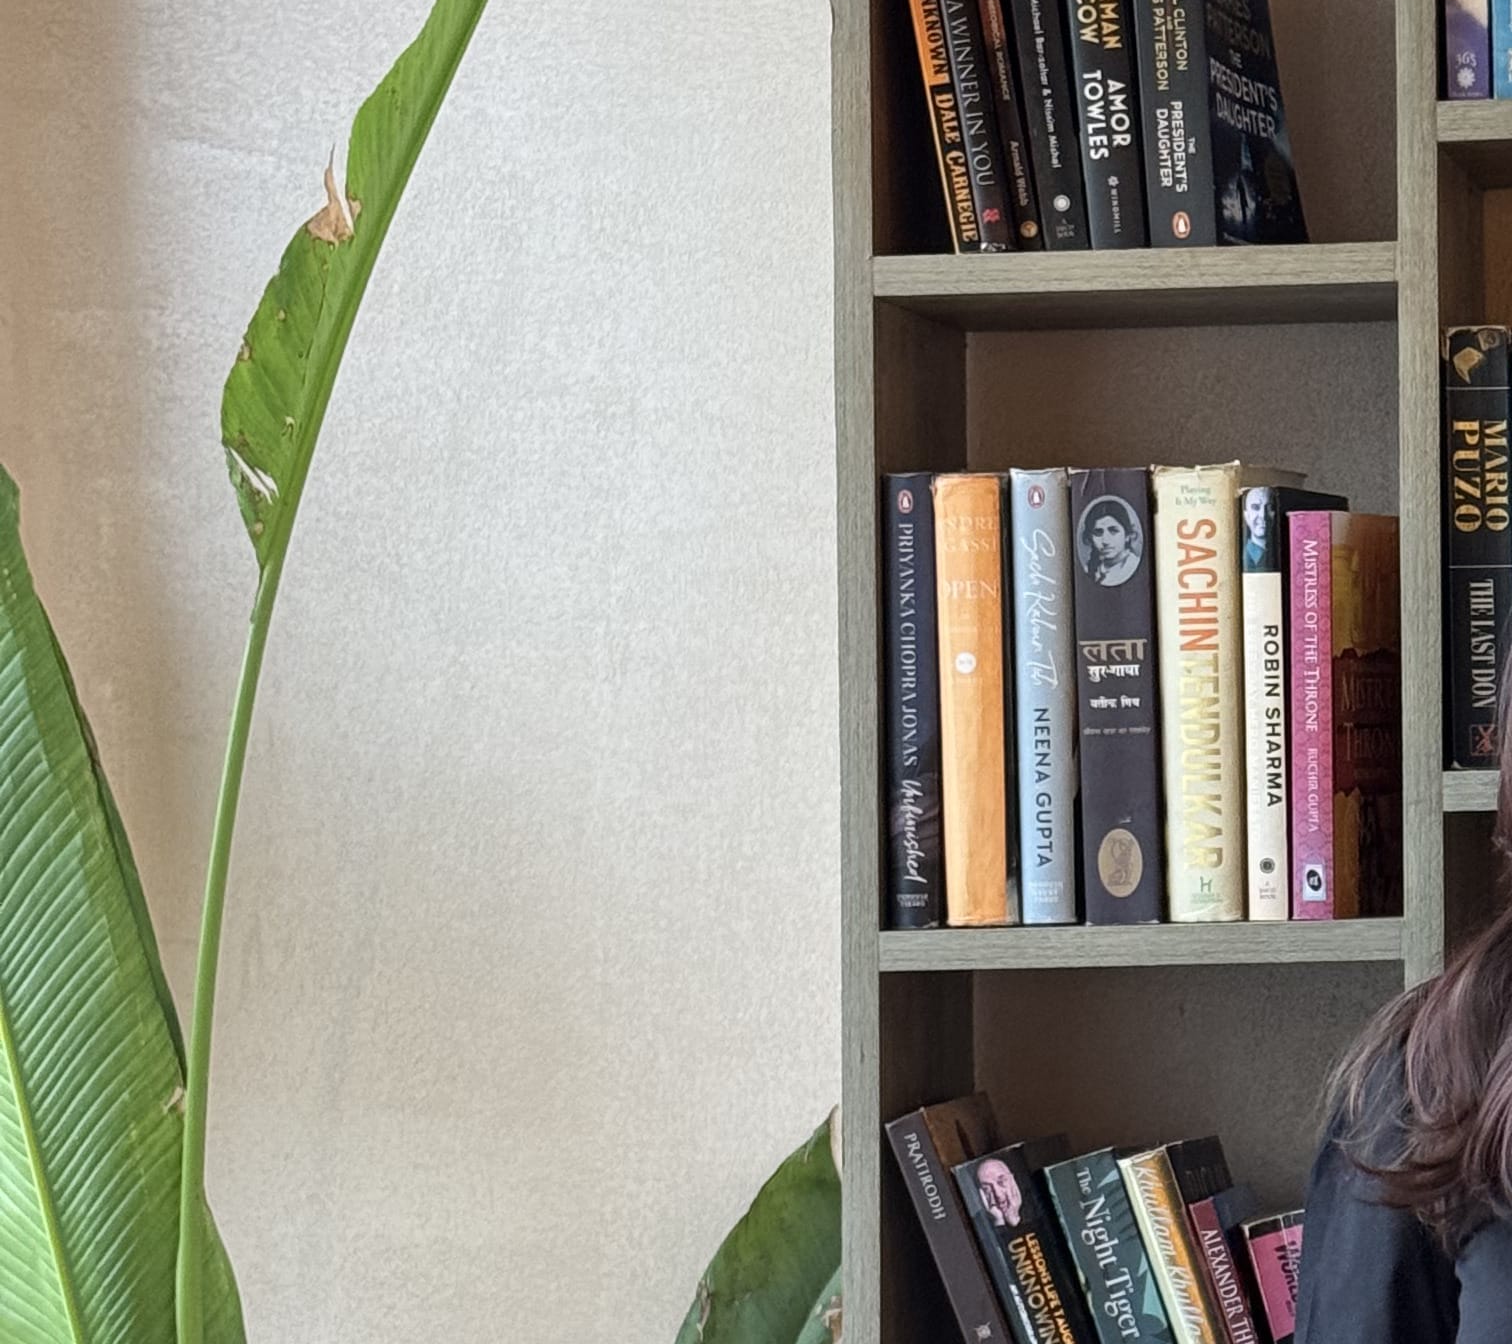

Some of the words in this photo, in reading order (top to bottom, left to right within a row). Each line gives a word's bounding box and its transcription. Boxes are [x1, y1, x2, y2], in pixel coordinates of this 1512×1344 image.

[945, 0, 963, 13] A
[1173, 8, 1188, 71] CLINTON
[949, 15, 982, 107] WINNER
[1152, 7, 1169, 91] PATTERSON
[965, 112, 988, 135] IN
[1083, 70, 1108, 160] TOWLES
[1107, 79, 1131, 147] AMOR
[1156, 108, 1172, 186] DAUGHTER
[1170, 101, 1188, 193] PRESIDENT'S
[934, 92, 962, 144] DALE
[949, 150, 978, 242] CARNEGIE
[970, 140, 995, 186] YOU
[1453, 420, 1481, 533] PUZO
[1483, 419, 1509, 531] MARIO
[898, 523, 917, 619] PRIYANKA
[1176, 519, 1219, 652] SACHIN
[1302, 539, 1319, 609] MISTRESS
[1469, 579, 1494, 617] THE
[1079, 639, 1147, 662] लता
[1305, 611, 1318, 631] OF
[1305, 635, 1319, 664] THE
[1470, 620, 1495, 664] LAST
[900, 622, 918, 703] CHOPRA
[1262, 624, 1281, 698] ROBIN
[1472, 668, 1496, 708] DON
[901, 706, 919, 766] JONAS
[1304, 667, 1321, 732] THRONE
[1032, 707, 1051, 783] NEENA
[1178, 652, 1224, 870] TENDULKAR
[1264, 706, 1283, 806] SHARMA
[901, 779, 928, 883] Unfinished
[1035, 792, 1054, 867] GUPTA
[903, 1132, 946, 1221] PRATIRODH
[1075, 1167, 1095, 1195] The
[1078, 1195, 1116, 1265] Night
[1096, 1268, 1142, 1339] Tiger
[1201, 1228, 1247, 1316] ALEXANDER
